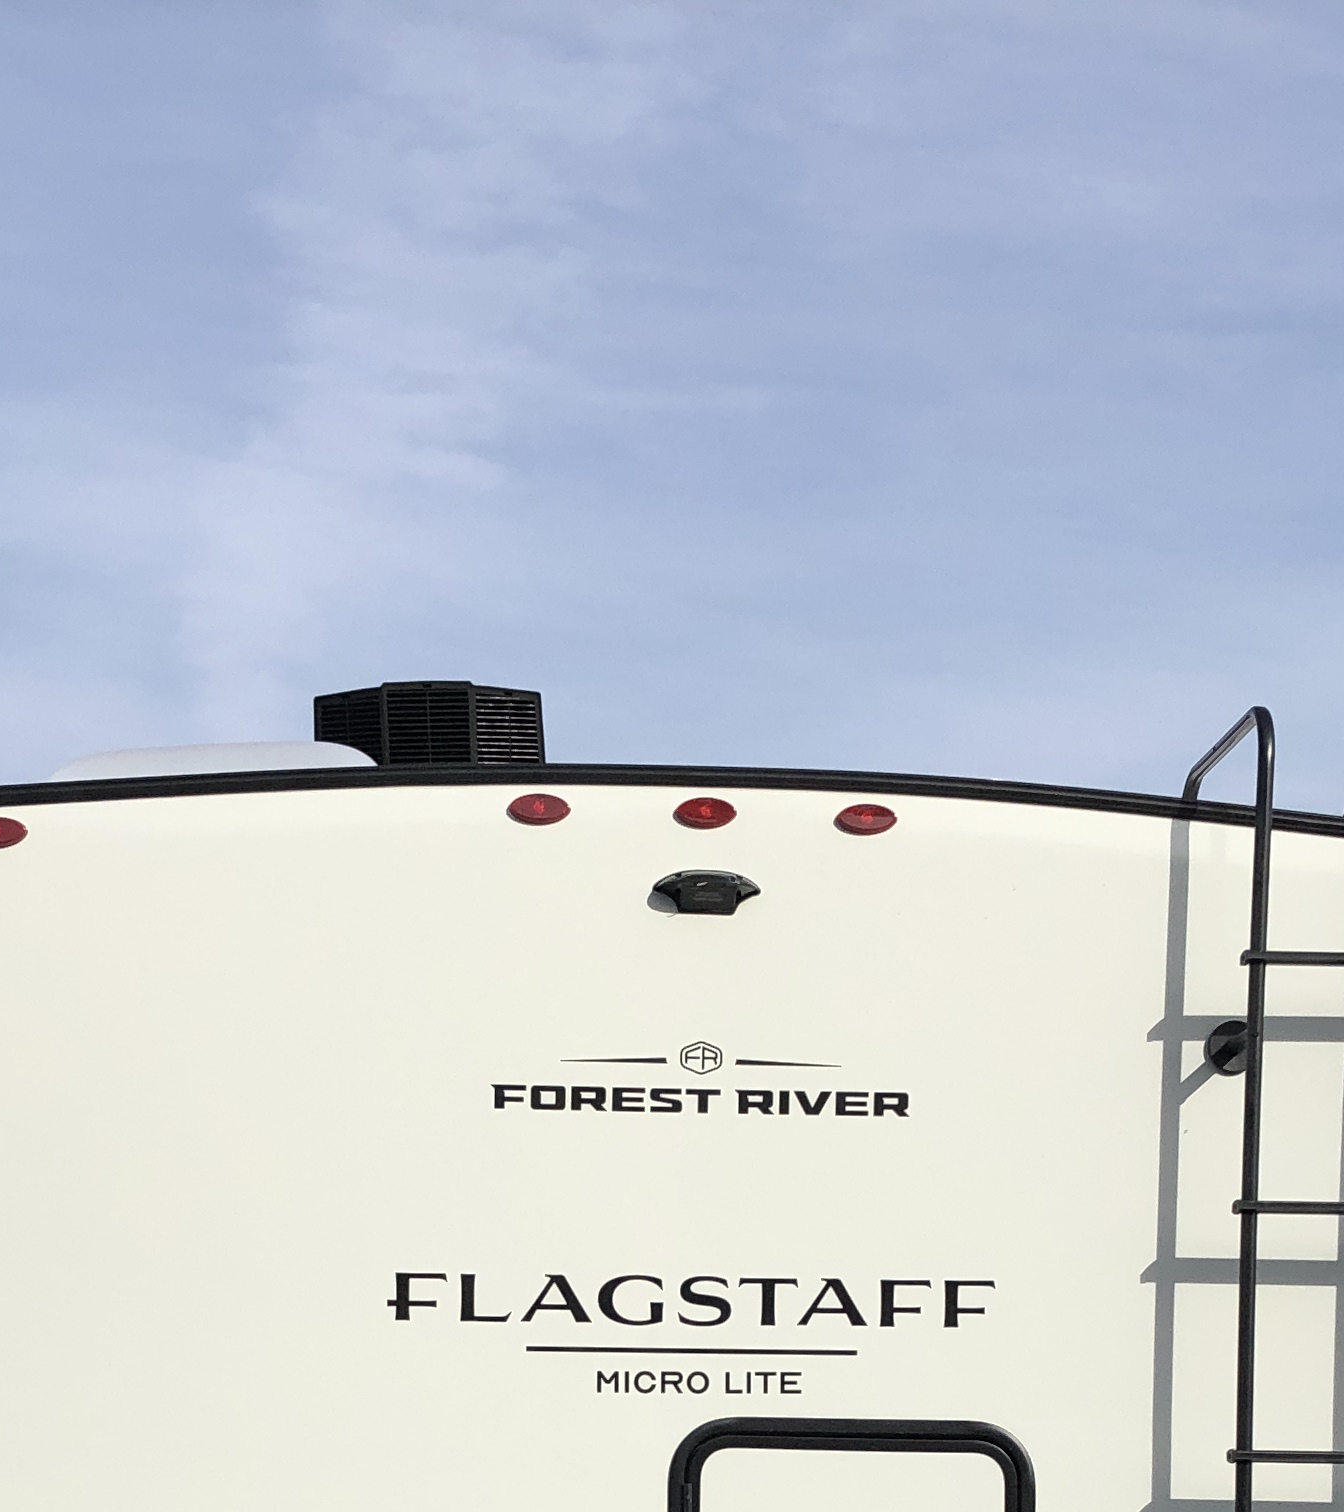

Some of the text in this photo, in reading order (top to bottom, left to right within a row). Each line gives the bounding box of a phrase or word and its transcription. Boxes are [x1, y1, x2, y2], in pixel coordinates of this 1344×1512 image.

[490, 1083, 910, 1118] FOREST RIVER
[386, 1272, 997, 1328] FLAGSTAFF
[596, 1370, 803, 1395] MICRO LITE
